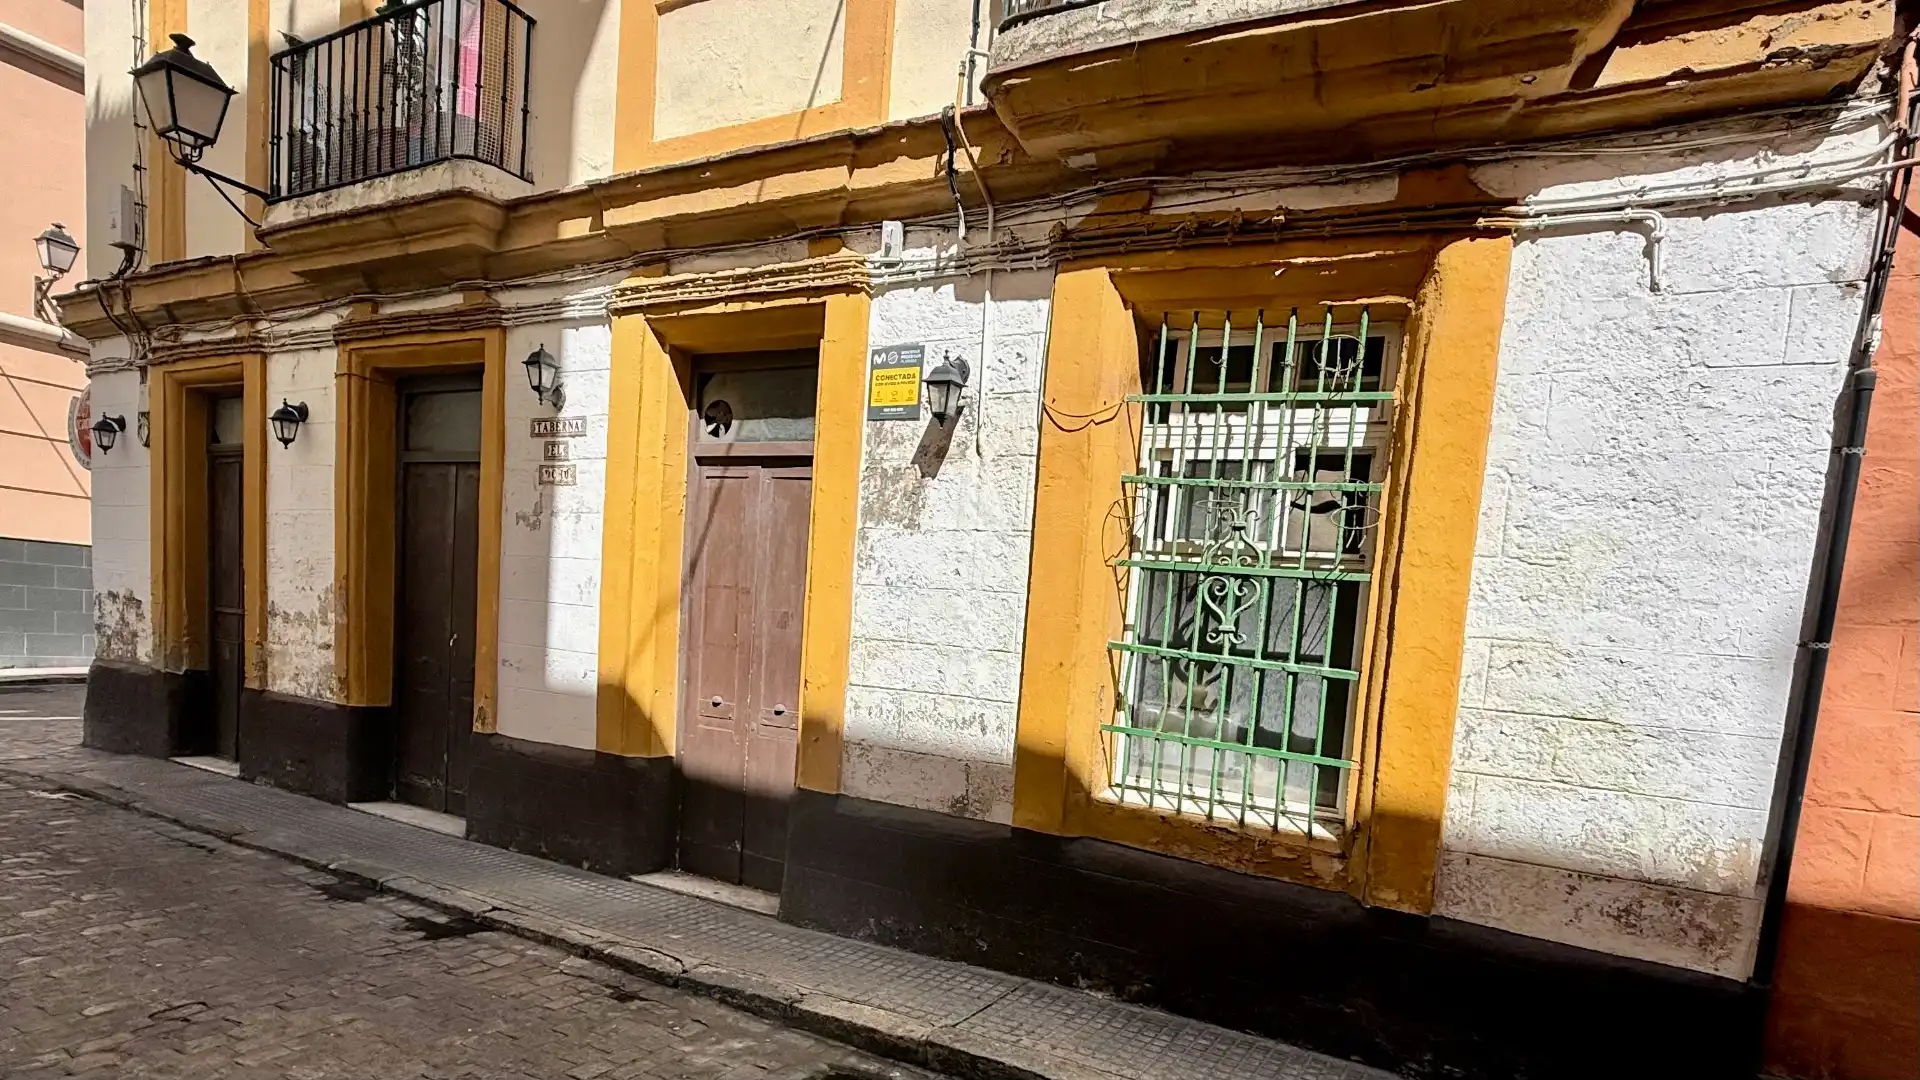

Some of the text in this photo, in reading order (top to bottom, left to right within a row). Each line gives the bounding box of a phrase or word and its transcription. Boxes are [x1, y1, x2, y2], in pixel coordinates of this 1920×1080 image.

[875, 373, 916, 381] CONECTADA
[536, 420, 580, 433] TABERNA
[551, 445, 563, 456] EL
